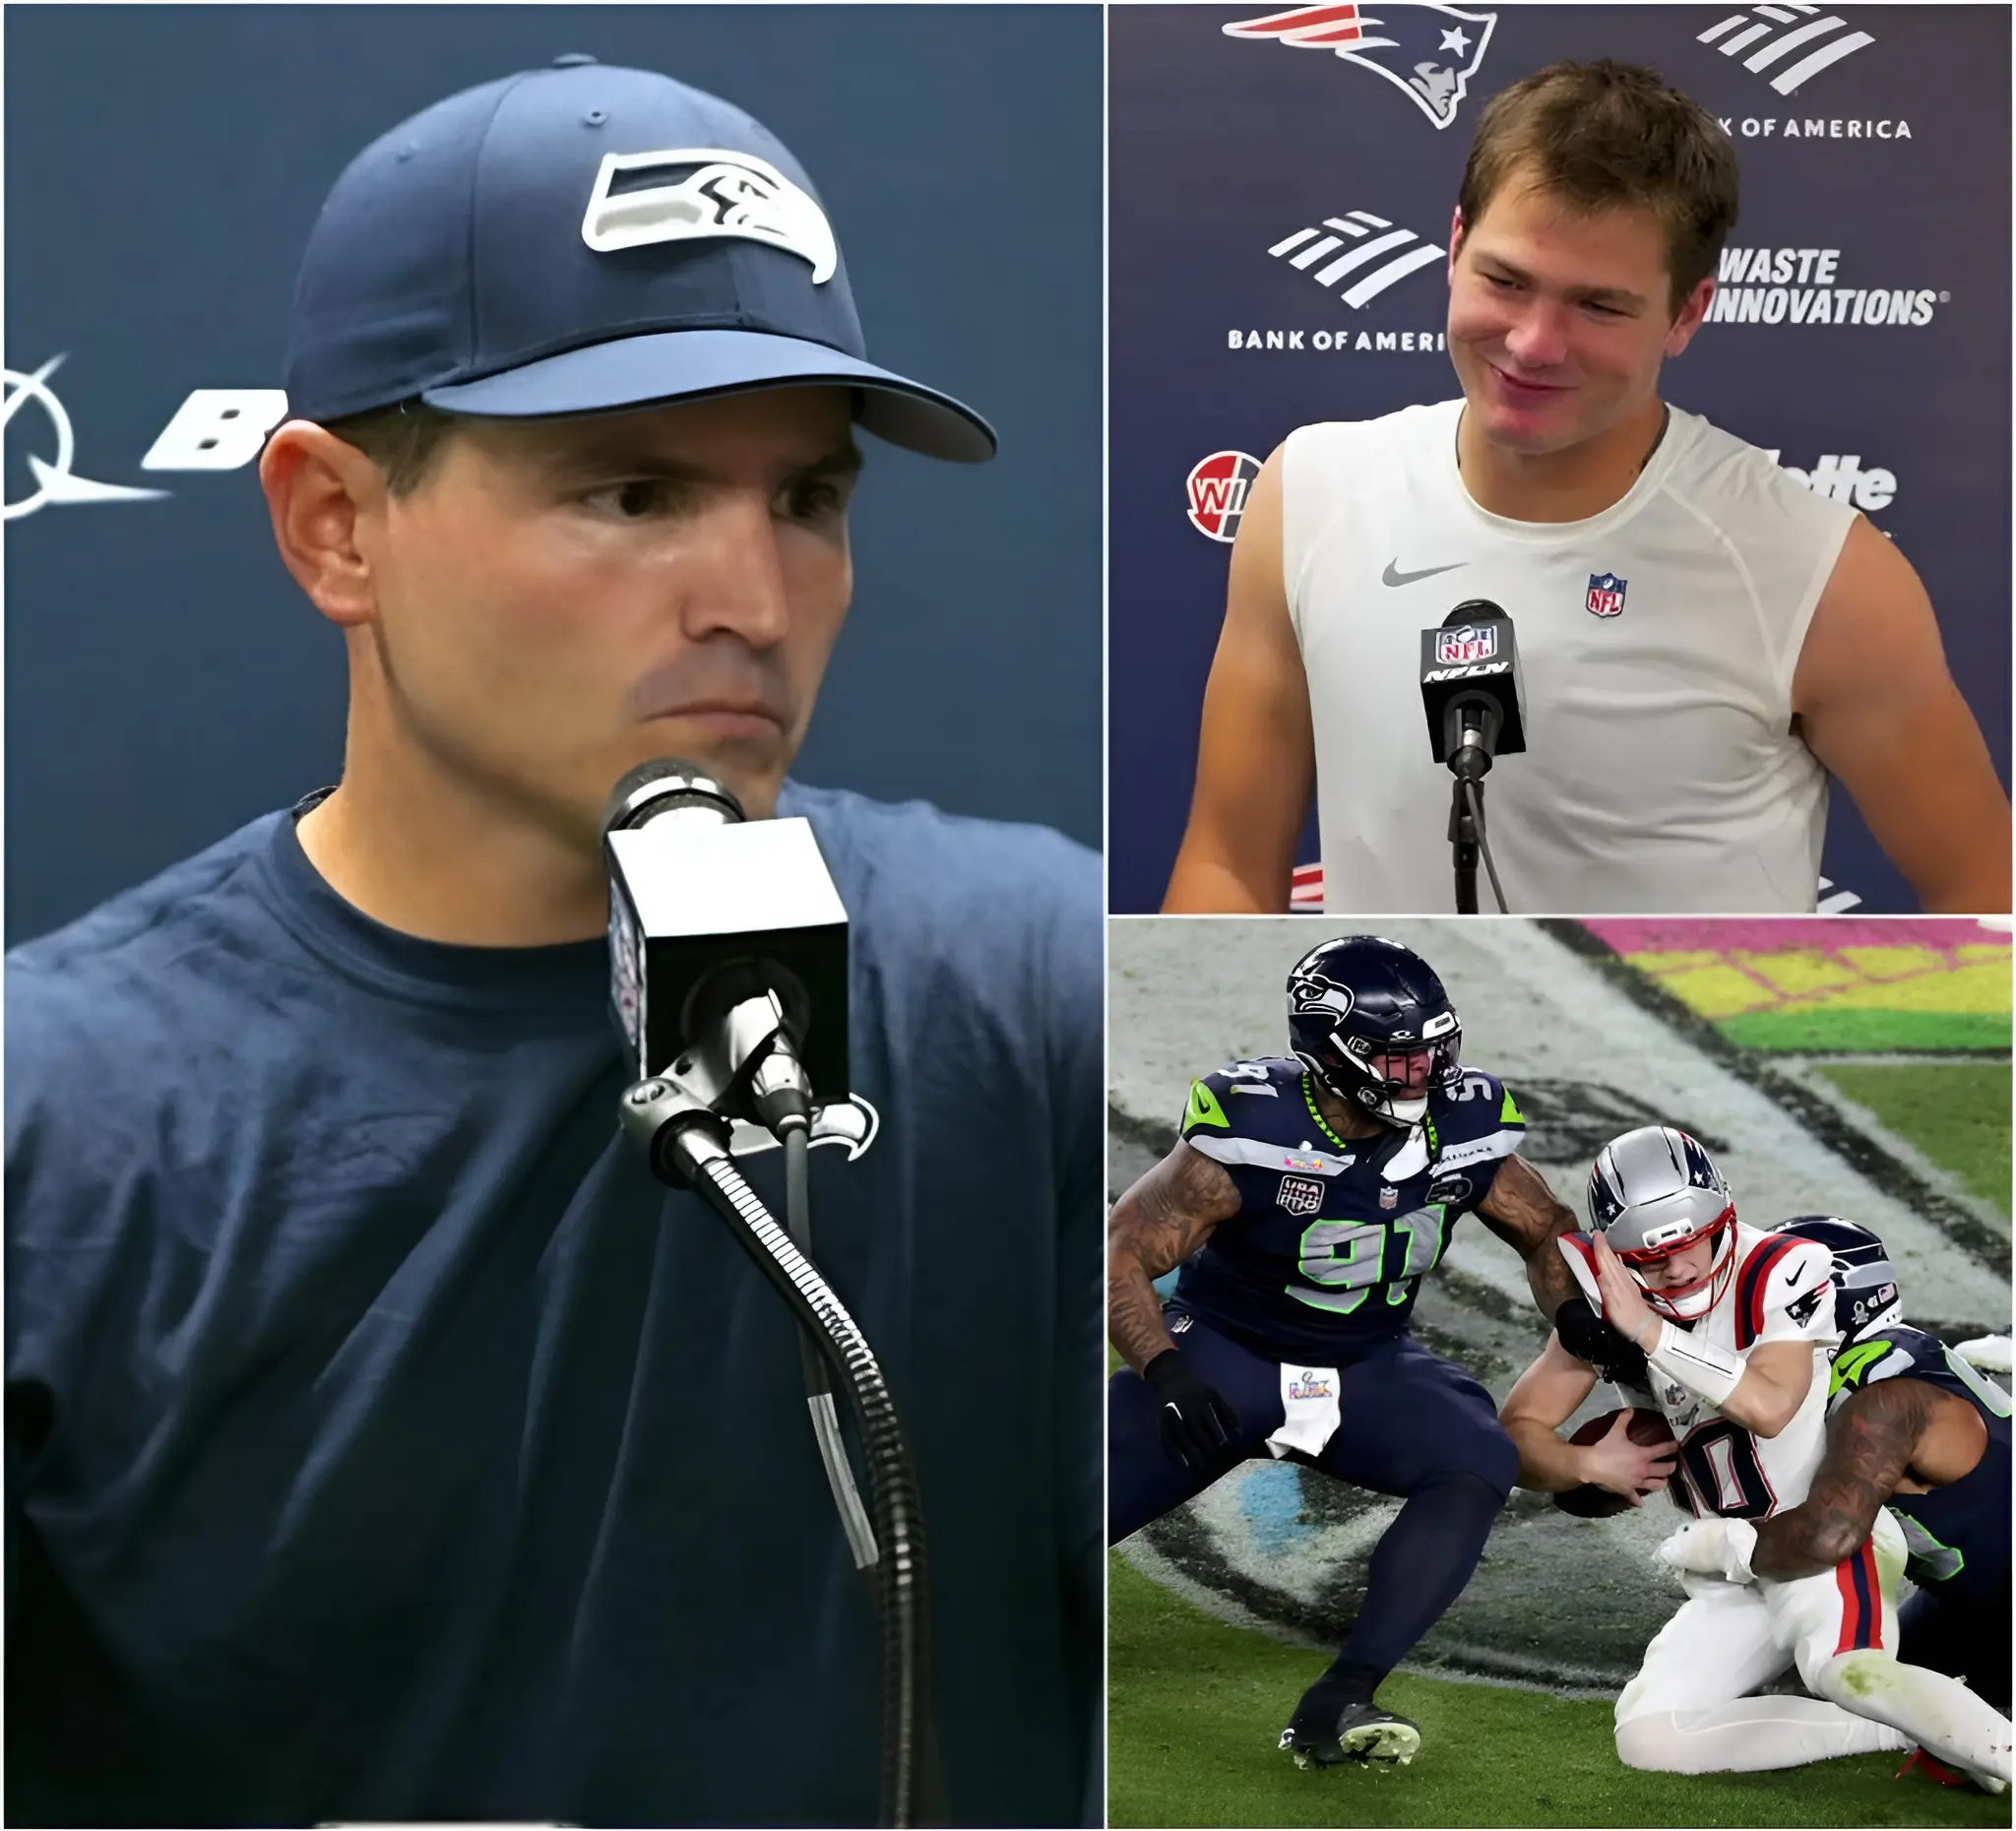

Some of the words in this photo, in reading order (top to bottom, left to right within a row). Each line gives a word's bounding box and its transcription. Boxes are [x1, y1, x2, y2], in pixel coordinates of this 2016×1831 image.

[1741, 117, 1777, 138] OF
[1783, 118, 1913, 139] AMERICA
[1718, 248, 1841, 284] WASTE
[1228, 329, 1305, 350] BANK
[1312, 330, 1349, 350] OF
[1284, 1204, 1446, 1314] 91
